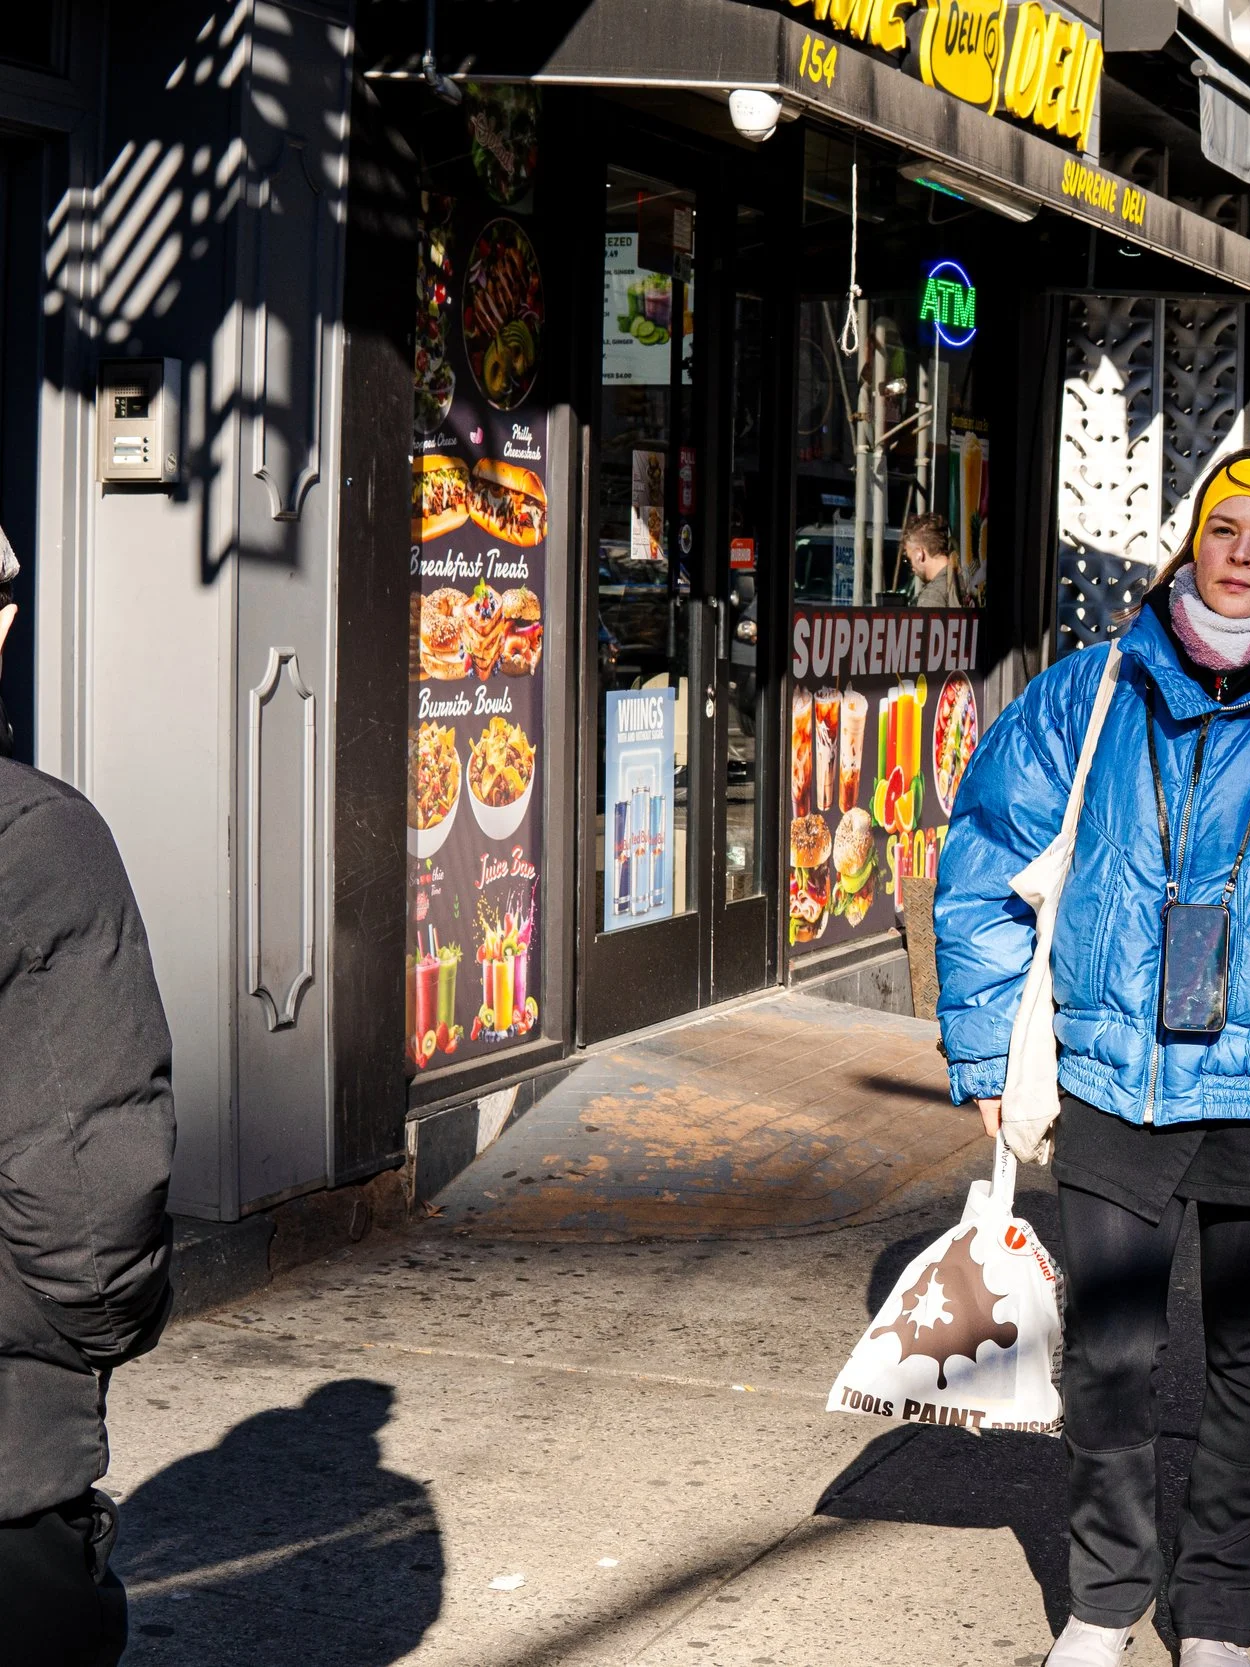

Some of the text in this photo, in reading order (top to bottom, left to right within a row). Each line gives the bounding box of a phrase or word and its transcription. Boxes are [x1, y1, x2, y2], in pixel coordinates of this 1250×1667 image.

[944, 2, 983, 57] DELI
[799, 33, 838, 89] 154
[1004, 1, 1103, 152] DELI
[1061, 158, 1146, 226] SUPREME DELI
[605, 236, 633, 247] EZED
[920, 278, 976, 328] ATM
[503, 440, 542, 461] Cheesesteak
[511, 423, 533, 447] Philly
[680, 451, 696, 465] PULL
[410, 545, 529, 582] Breakfast Treats
[792, 614, 979, 679] SUPREME DELI
[418, 684, 513, 719] Burrito Bowls
[618, 696, 664, 732] WIIINGS
[474, 844, 536, 890] Juice Bar
[840, 1385, 894, 1417] TOOLS
[902, 1398, 987, 1428] PAINT
